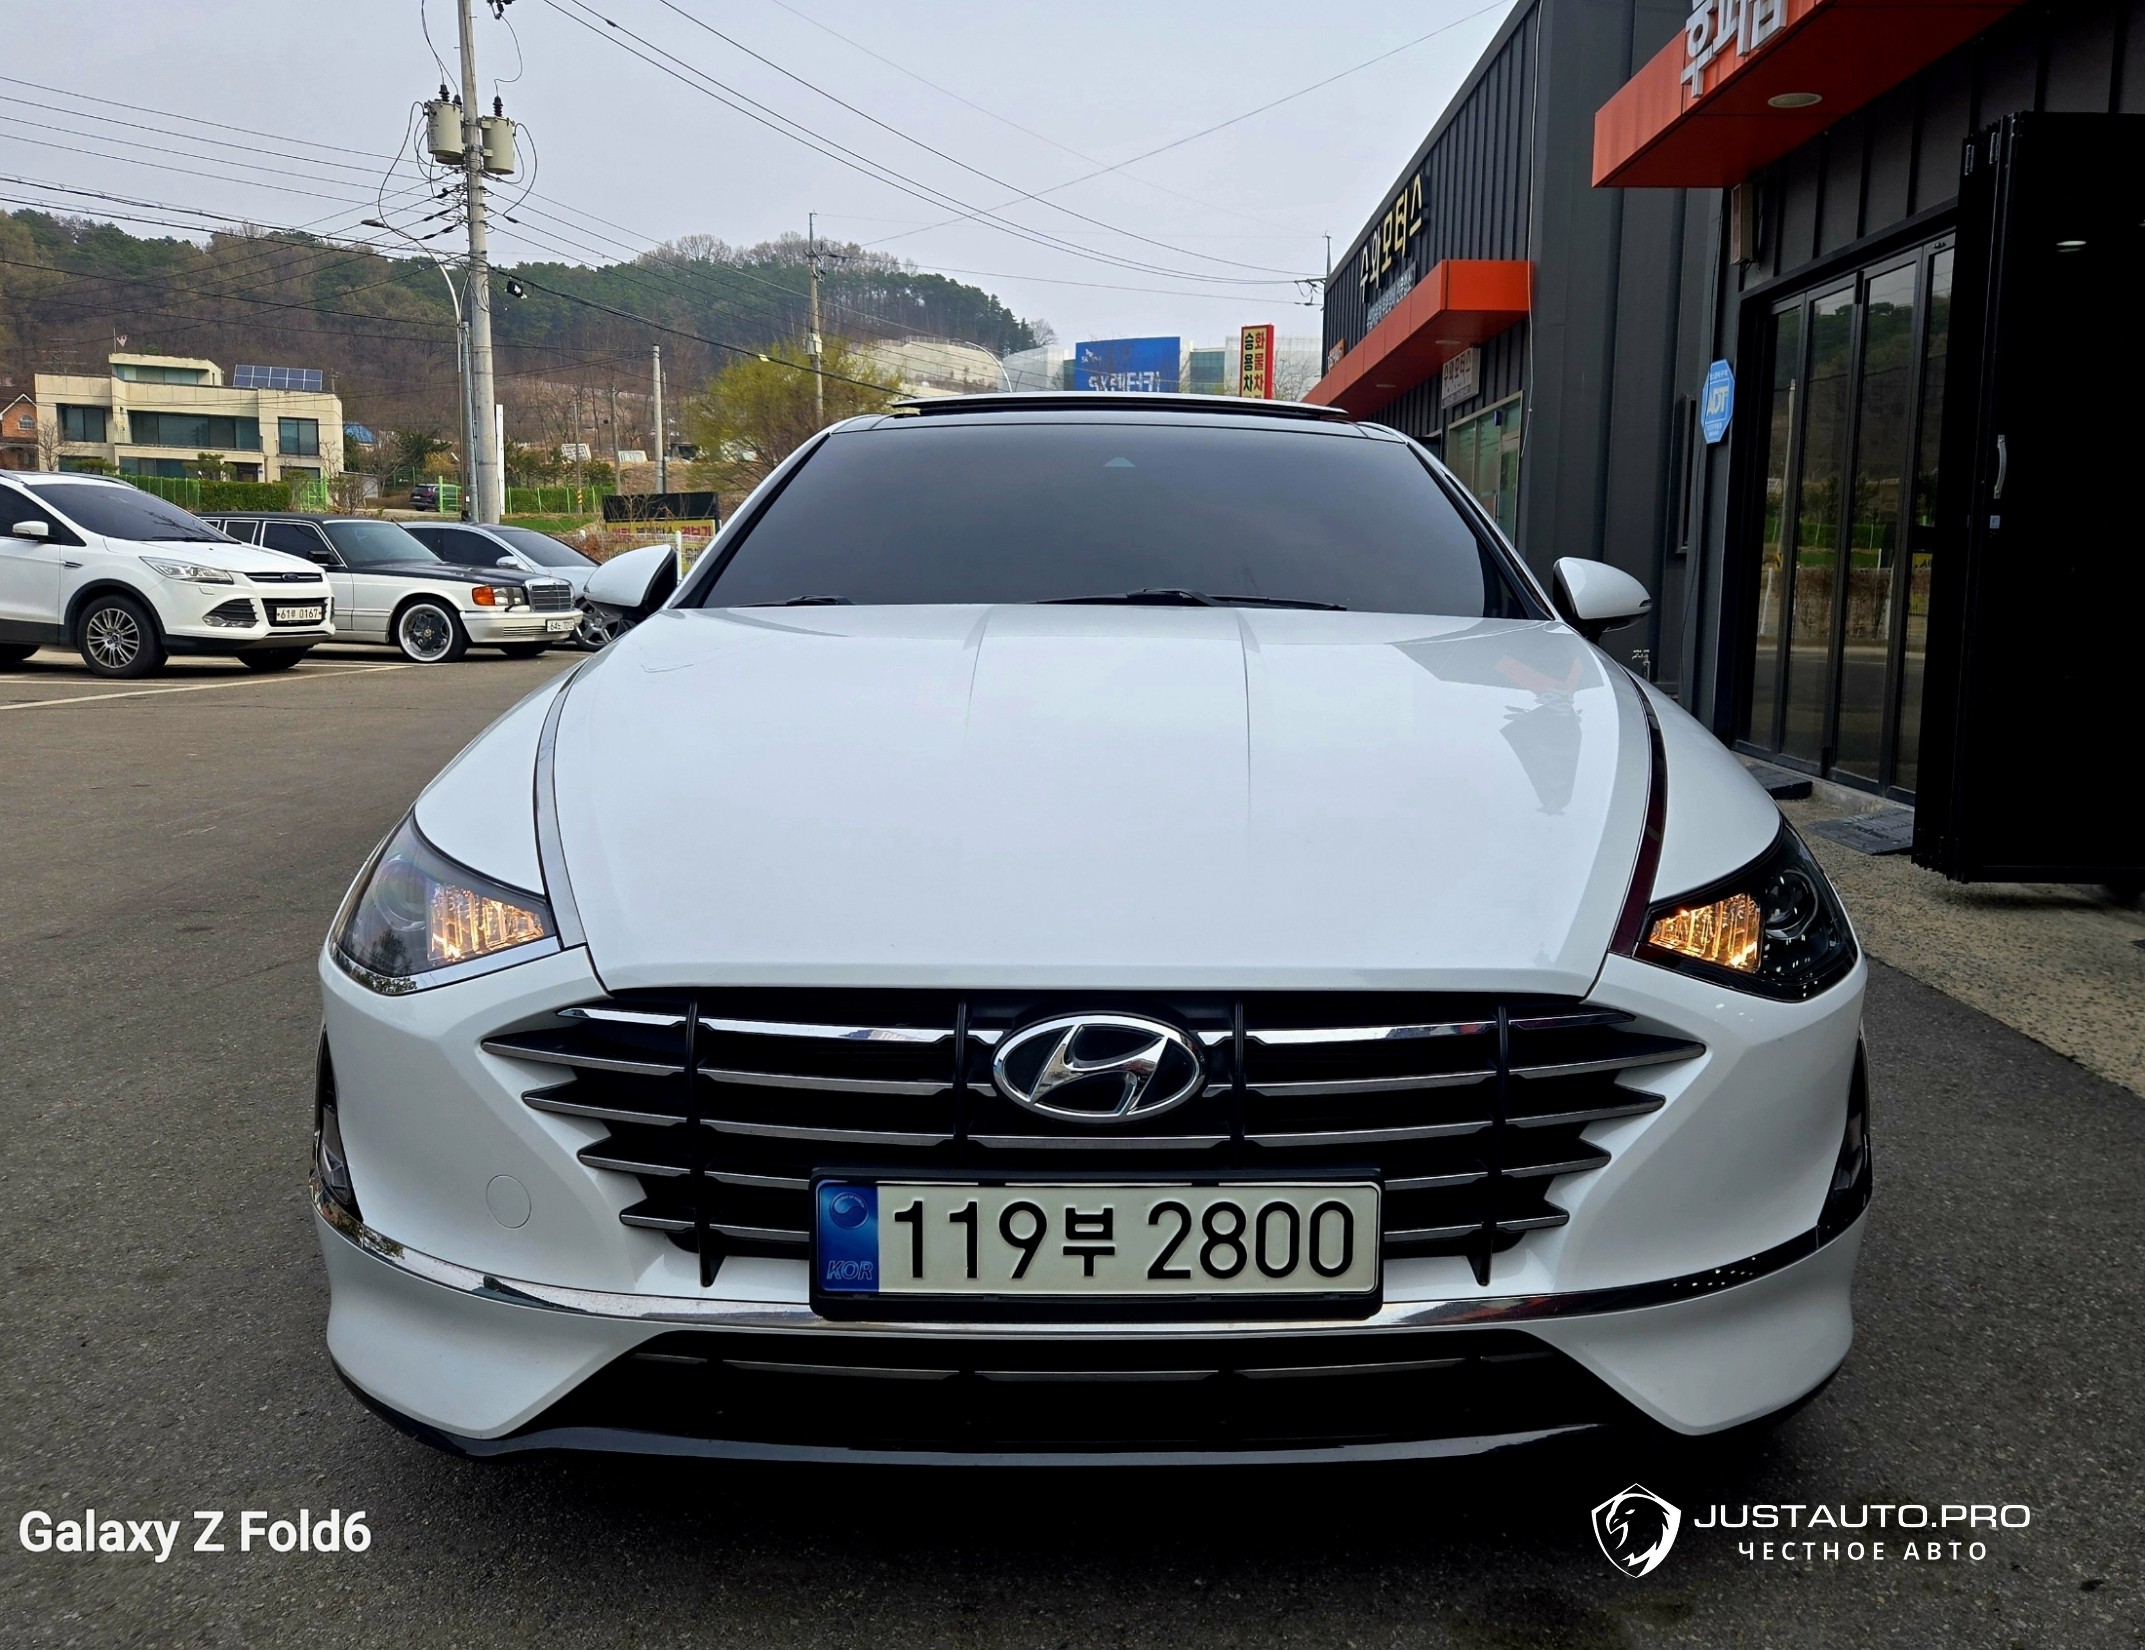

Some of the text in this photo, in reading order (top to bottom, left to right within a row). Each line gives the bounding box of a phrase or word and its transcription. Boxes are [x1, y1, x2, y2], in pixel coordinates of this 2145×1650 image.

[1360, 173, 1422, 303] 수와모터스
[1244, 332, 1253, 392] 승용차
[1254, 331, 1265, 392] 화물차
[1707, 386, 1728, 415] ADT
[299, 608, 318, 619] 0167
[894, 1200, 1354, 1279] 119부 2800
[826, 1261, 873, 1280] KOR
